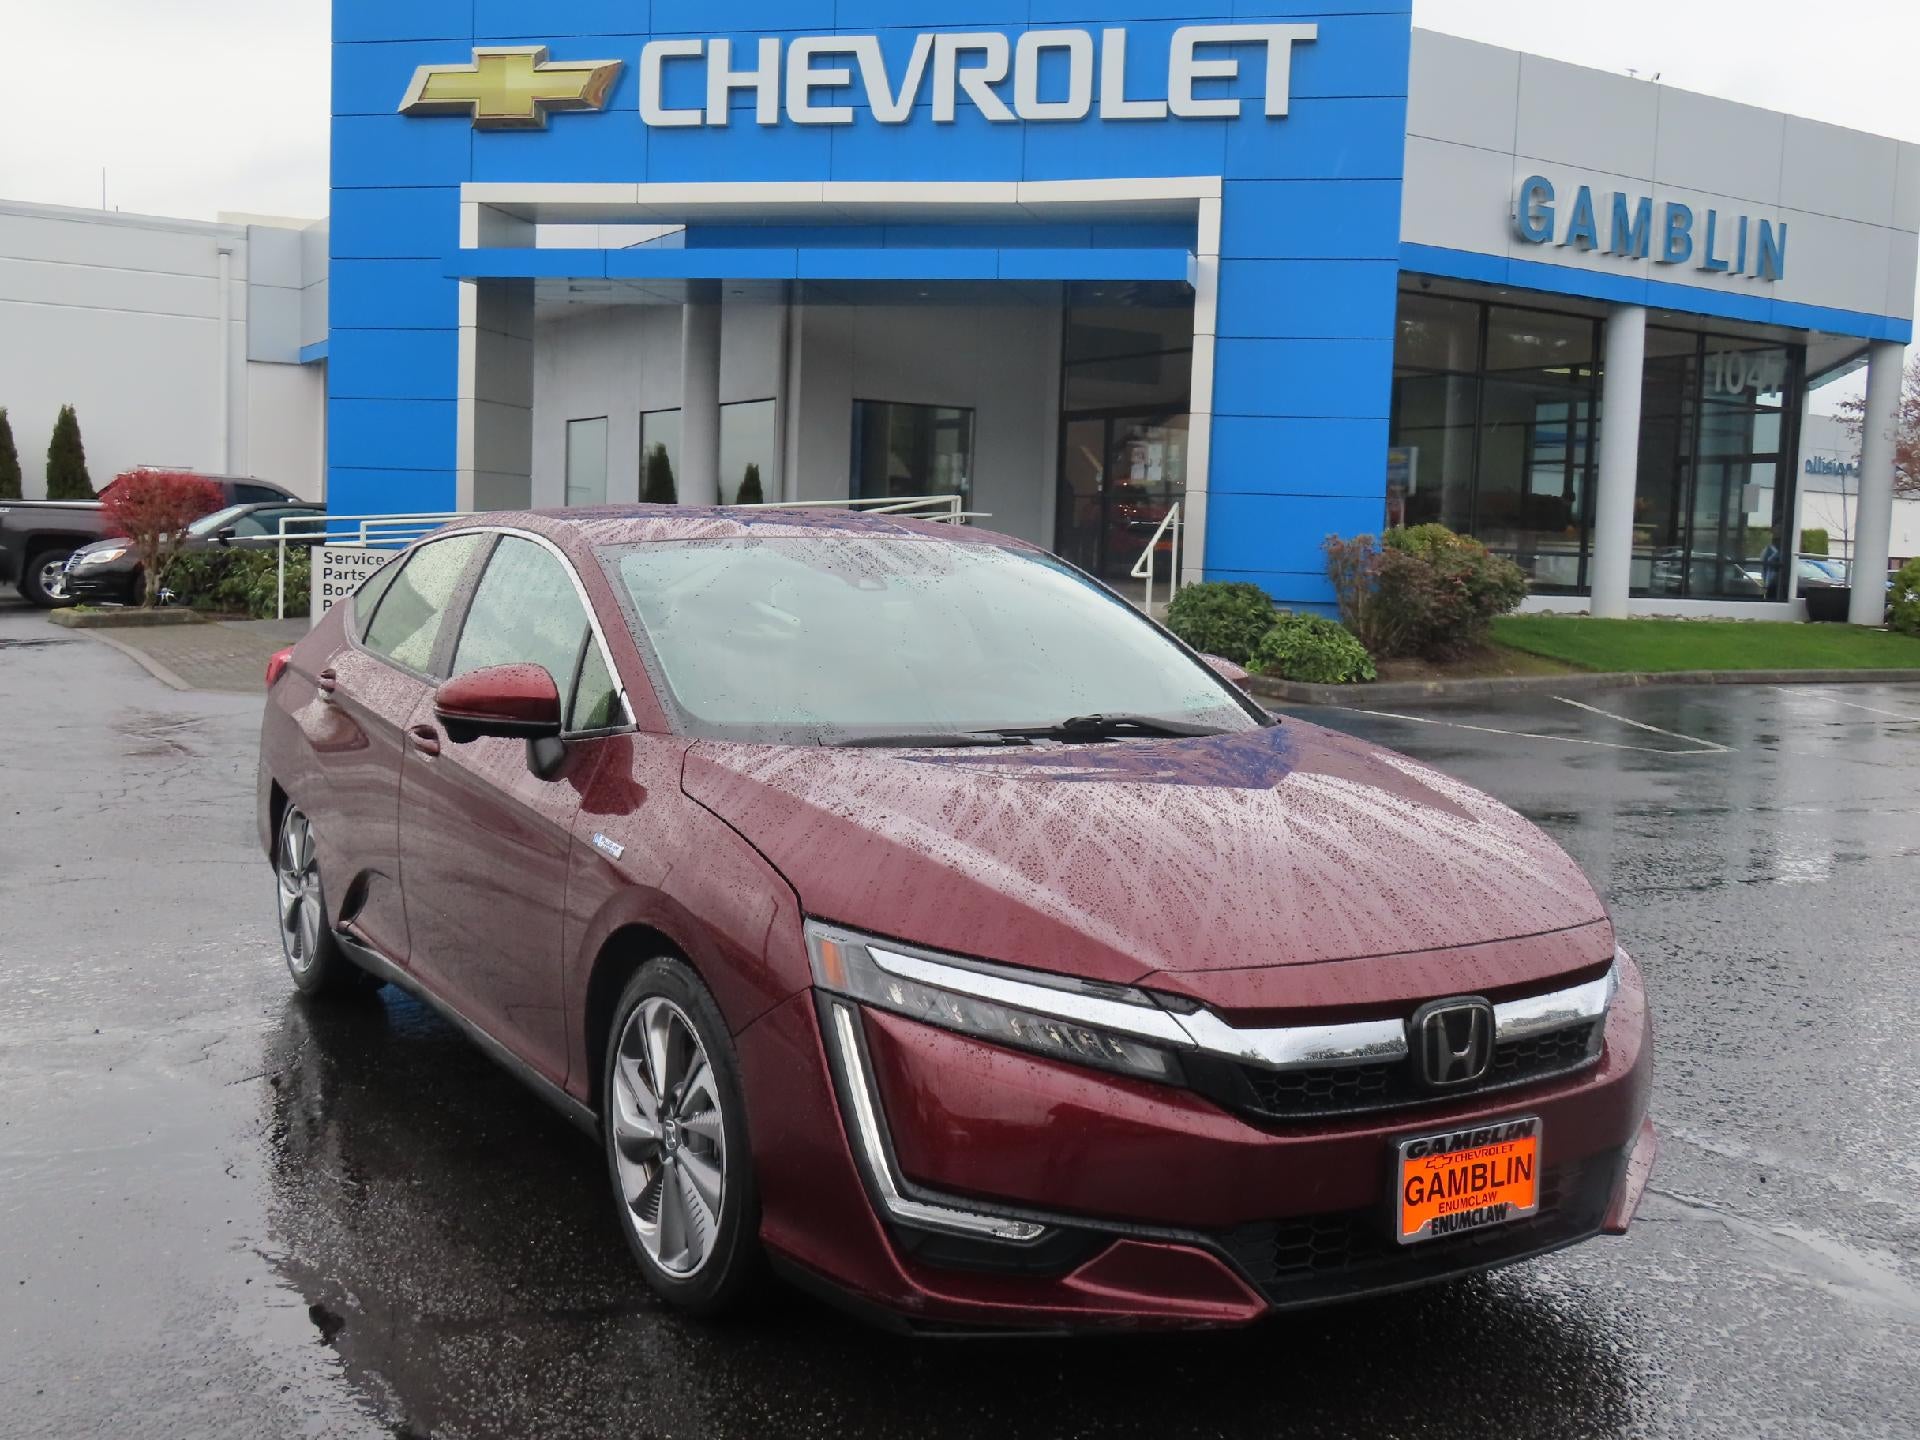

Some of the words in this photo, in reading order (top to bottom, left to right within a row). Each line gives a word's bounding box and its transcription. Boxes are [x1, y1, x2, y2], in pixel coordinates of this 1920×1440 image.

[639, 22, 1319, 127] CHEVROLET
[1516, 175, 1787, 281] GAMBLIN
[323, 551, 385, 566] Service
[323, 567, 366, 581] Parts
[1406, 1119, 1536, 1160] GAMBLIN
[1454, 1143, 1515, 1164] CHEVROLET
[1404, 1153, 1533, 1207] GAMBLIN
[1431, 1202, 1508, 1236] ENUMCLAW
[1438, 1191, 1498, 1214] ENUMCLAW
